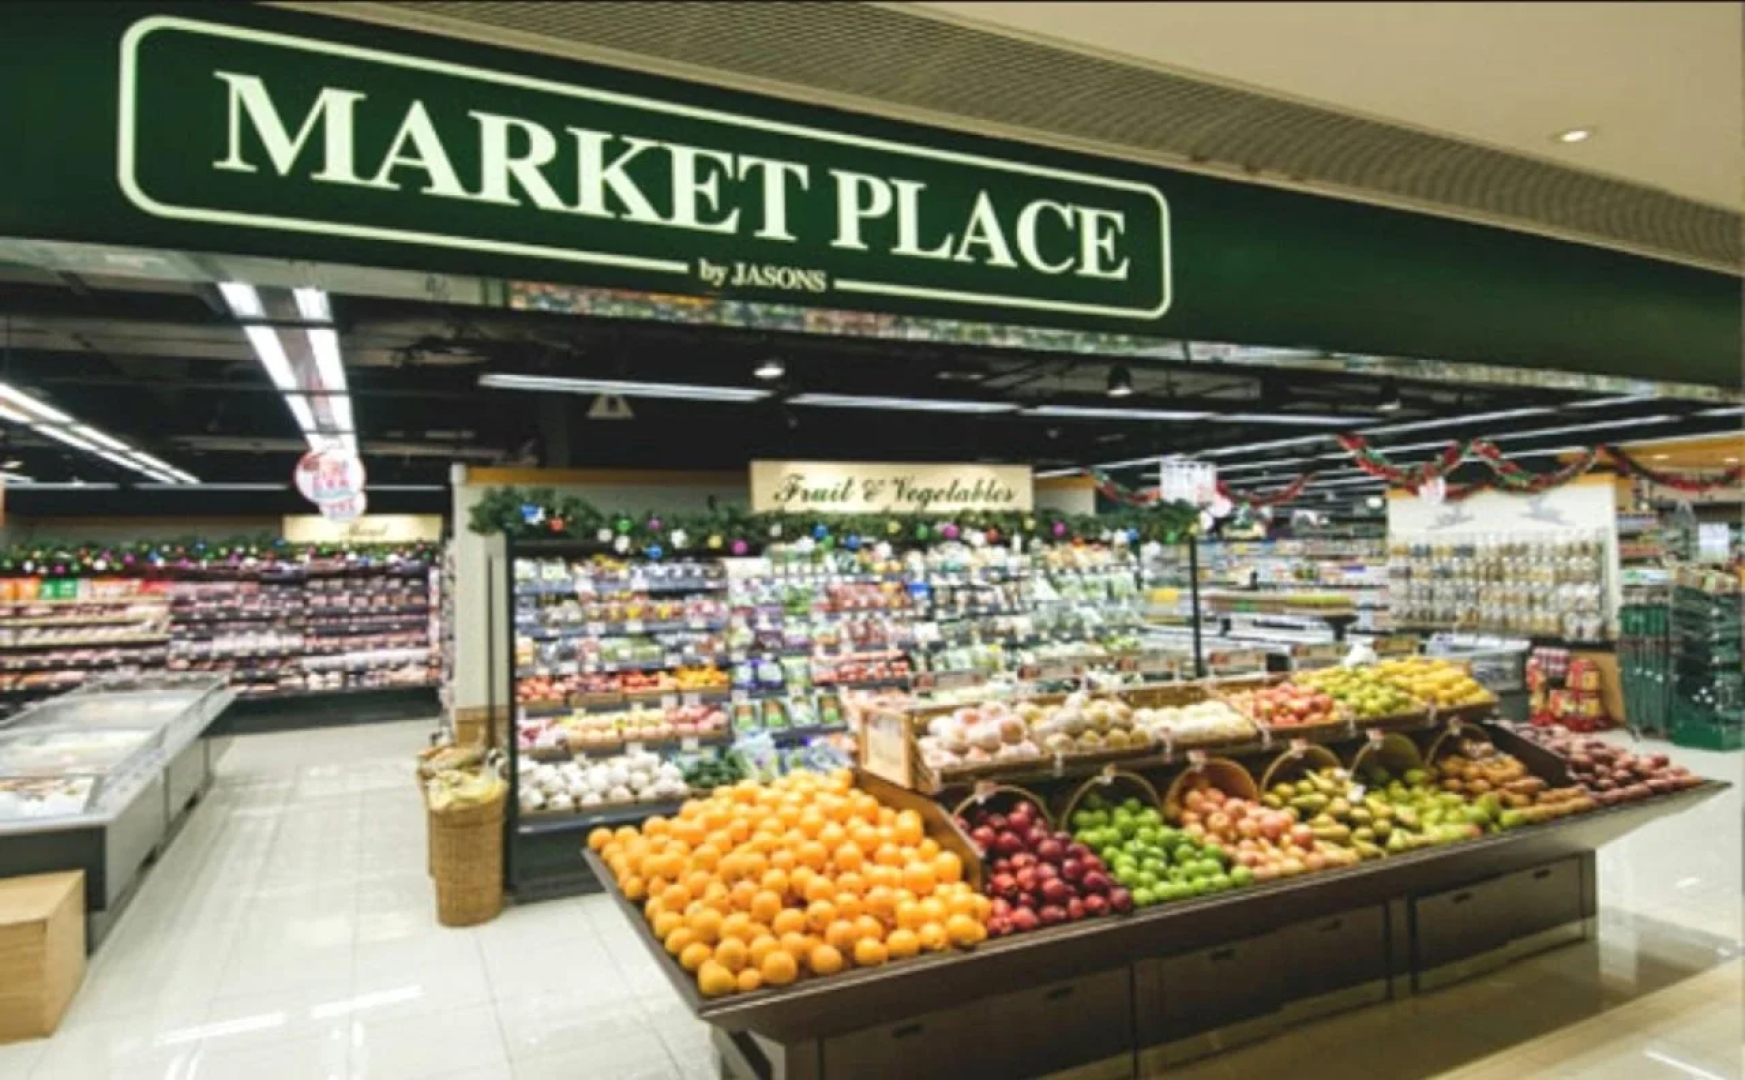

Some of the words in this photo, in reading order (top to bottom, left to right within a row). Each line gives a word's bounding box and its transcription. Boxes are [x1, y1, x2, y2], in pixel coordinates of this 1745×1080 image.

[213, 70, 809, 242] MARKET
[829, 168, 1130, 280] PLACE
[699, 258, 728, 287] by
[731, 263, 827, 292] JASONS
[773, 473, 854, 502] Fruit
[862, 478, 885, 501] &
[892, 475, 1017, 506] Vegetables
